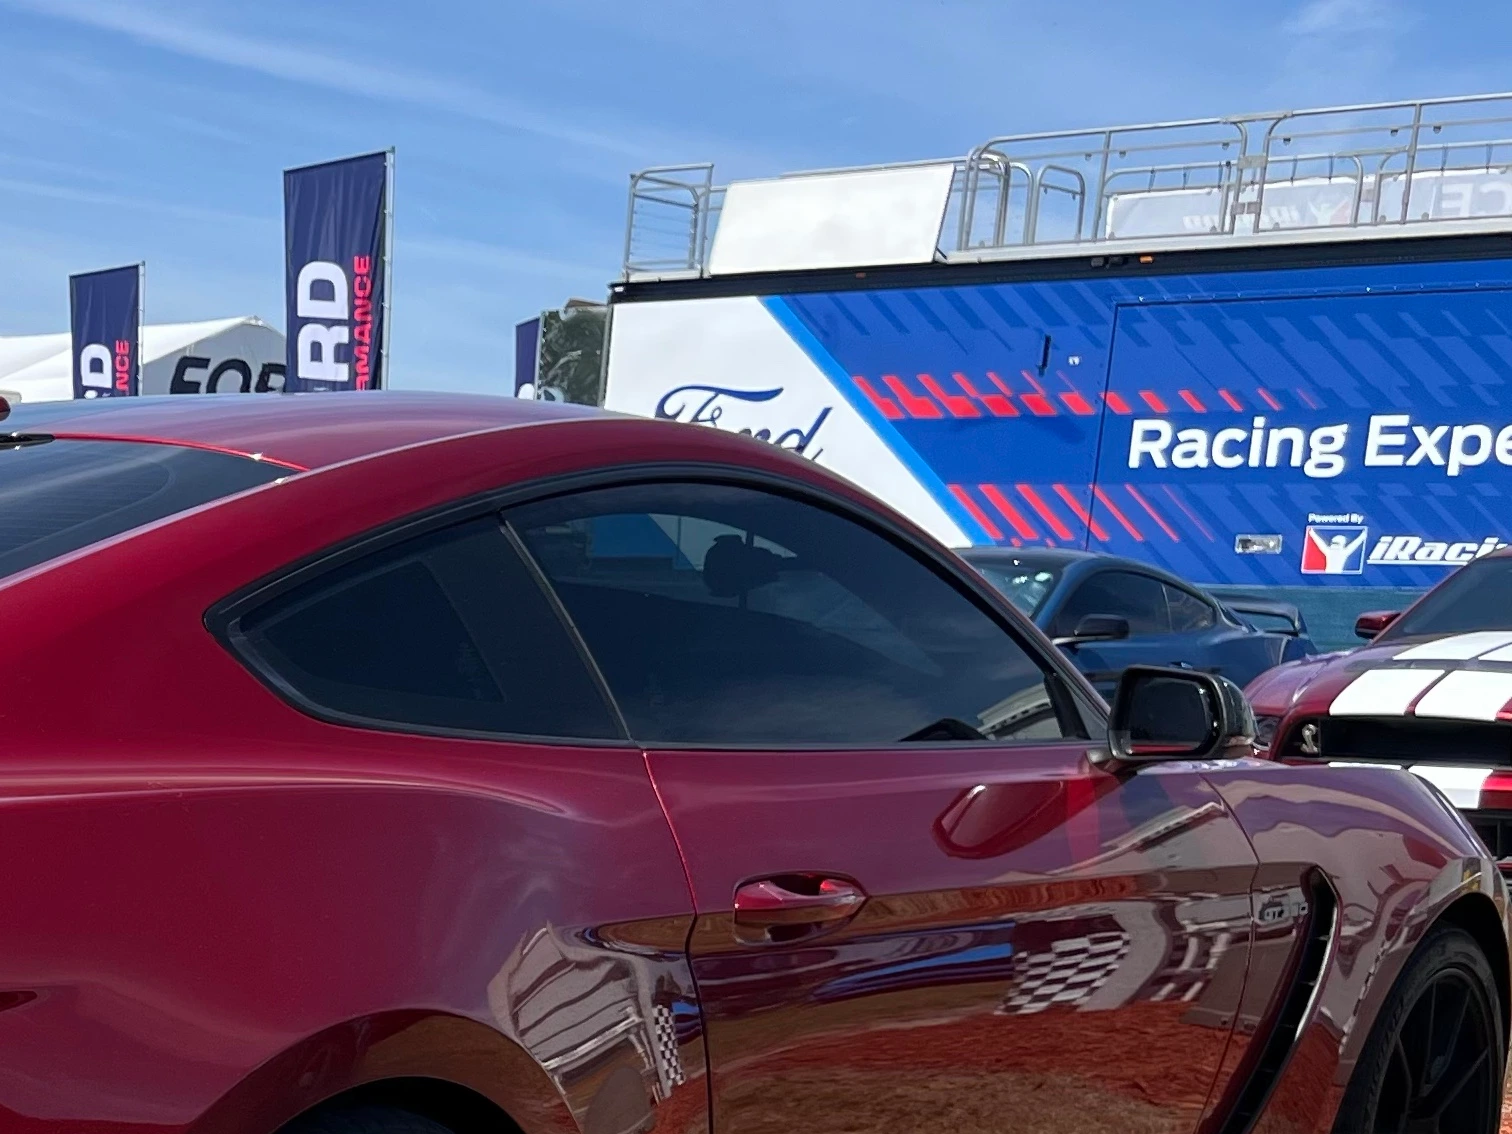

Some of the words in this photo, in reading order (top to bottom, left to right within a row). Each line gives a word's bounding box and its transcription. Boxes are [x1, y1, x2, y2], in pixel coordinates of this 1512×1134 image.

[655, 385, 833, 462] Fd
[1128, 416, 1349, 478] Racing
[1308, 513, 1349, 524] Powered
[1351, 514, 1364, 525] By
